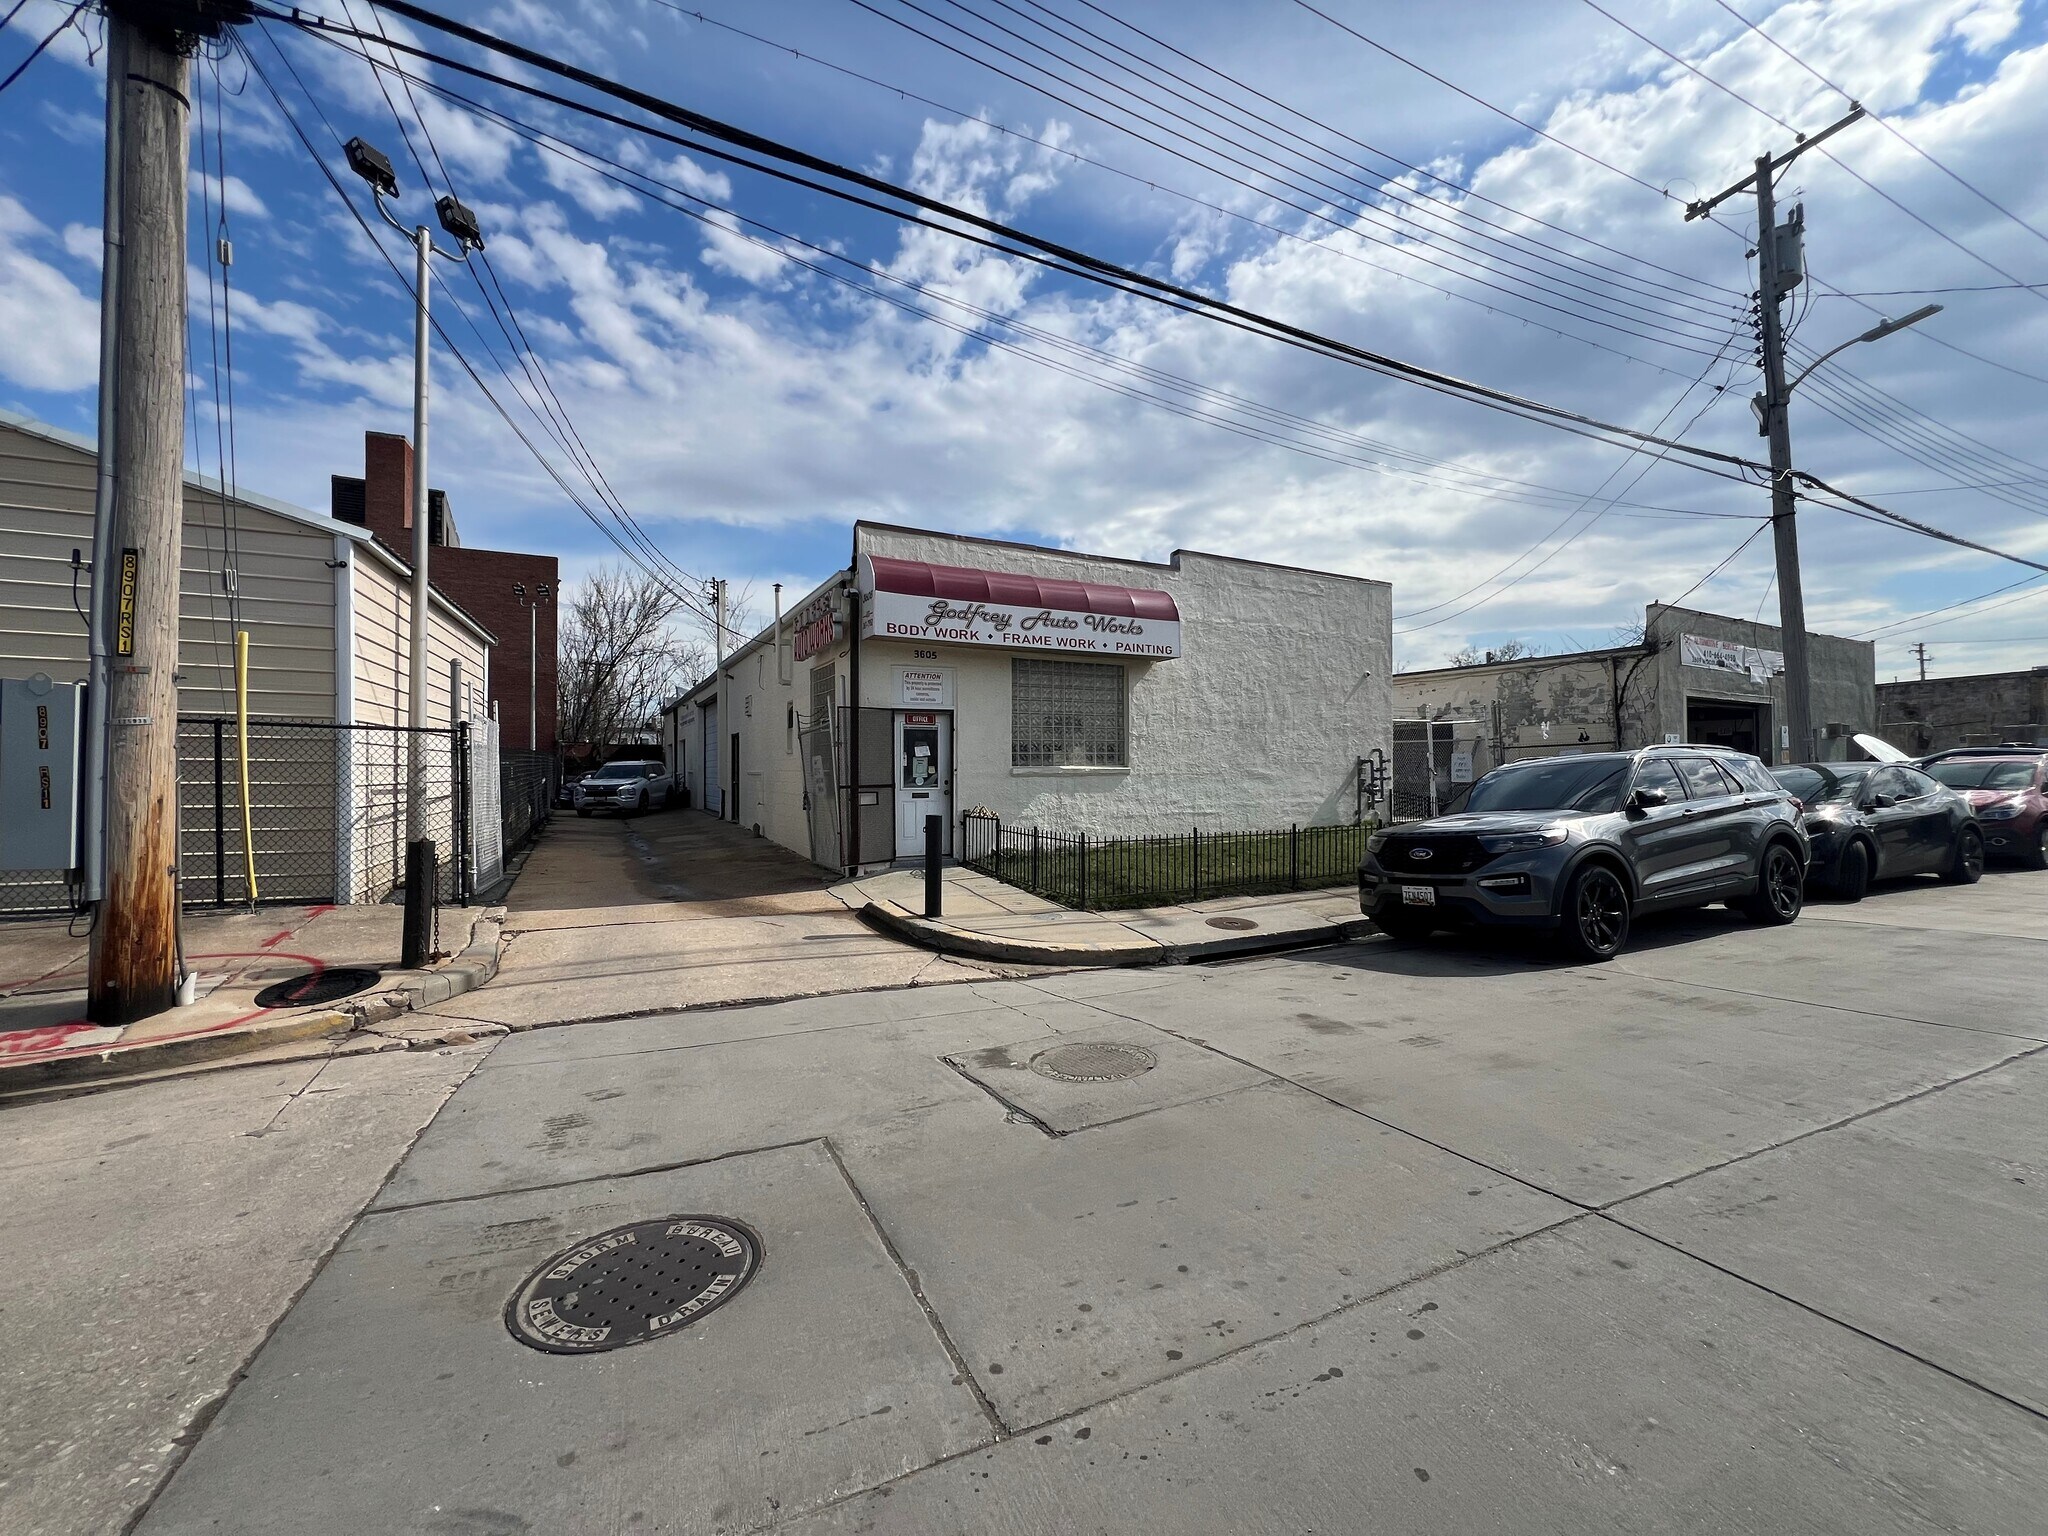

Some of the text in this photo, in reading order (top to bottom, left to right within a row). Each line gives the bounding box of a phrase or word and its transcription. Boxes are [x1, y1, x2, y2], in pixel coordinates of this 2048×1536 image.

[120, 556, 135, 653] 8907RS1
[924, 600, 1144, 636] Godfrey Auto Works
[886, 622, 929, 637] BODY
[934, 627, 980, 641] WORK
[1003, 633, 1052, 646] FRAME
[1056, 637, 1096, 650] WORK
[1115, 642, 1173, 655] PAINTING
[914, 650, 938, 659] 3605
[904, 672, 942, 680] ATTENTION
[38, 706, 48, 749] 8907
[551, 1234, 630, 1278] STORM
[670, 1226, 740, 1255] BUREAU
[531, 1299, 604, 1341] SEWERS
[657, 1278, 733, 1327] DRAIN
